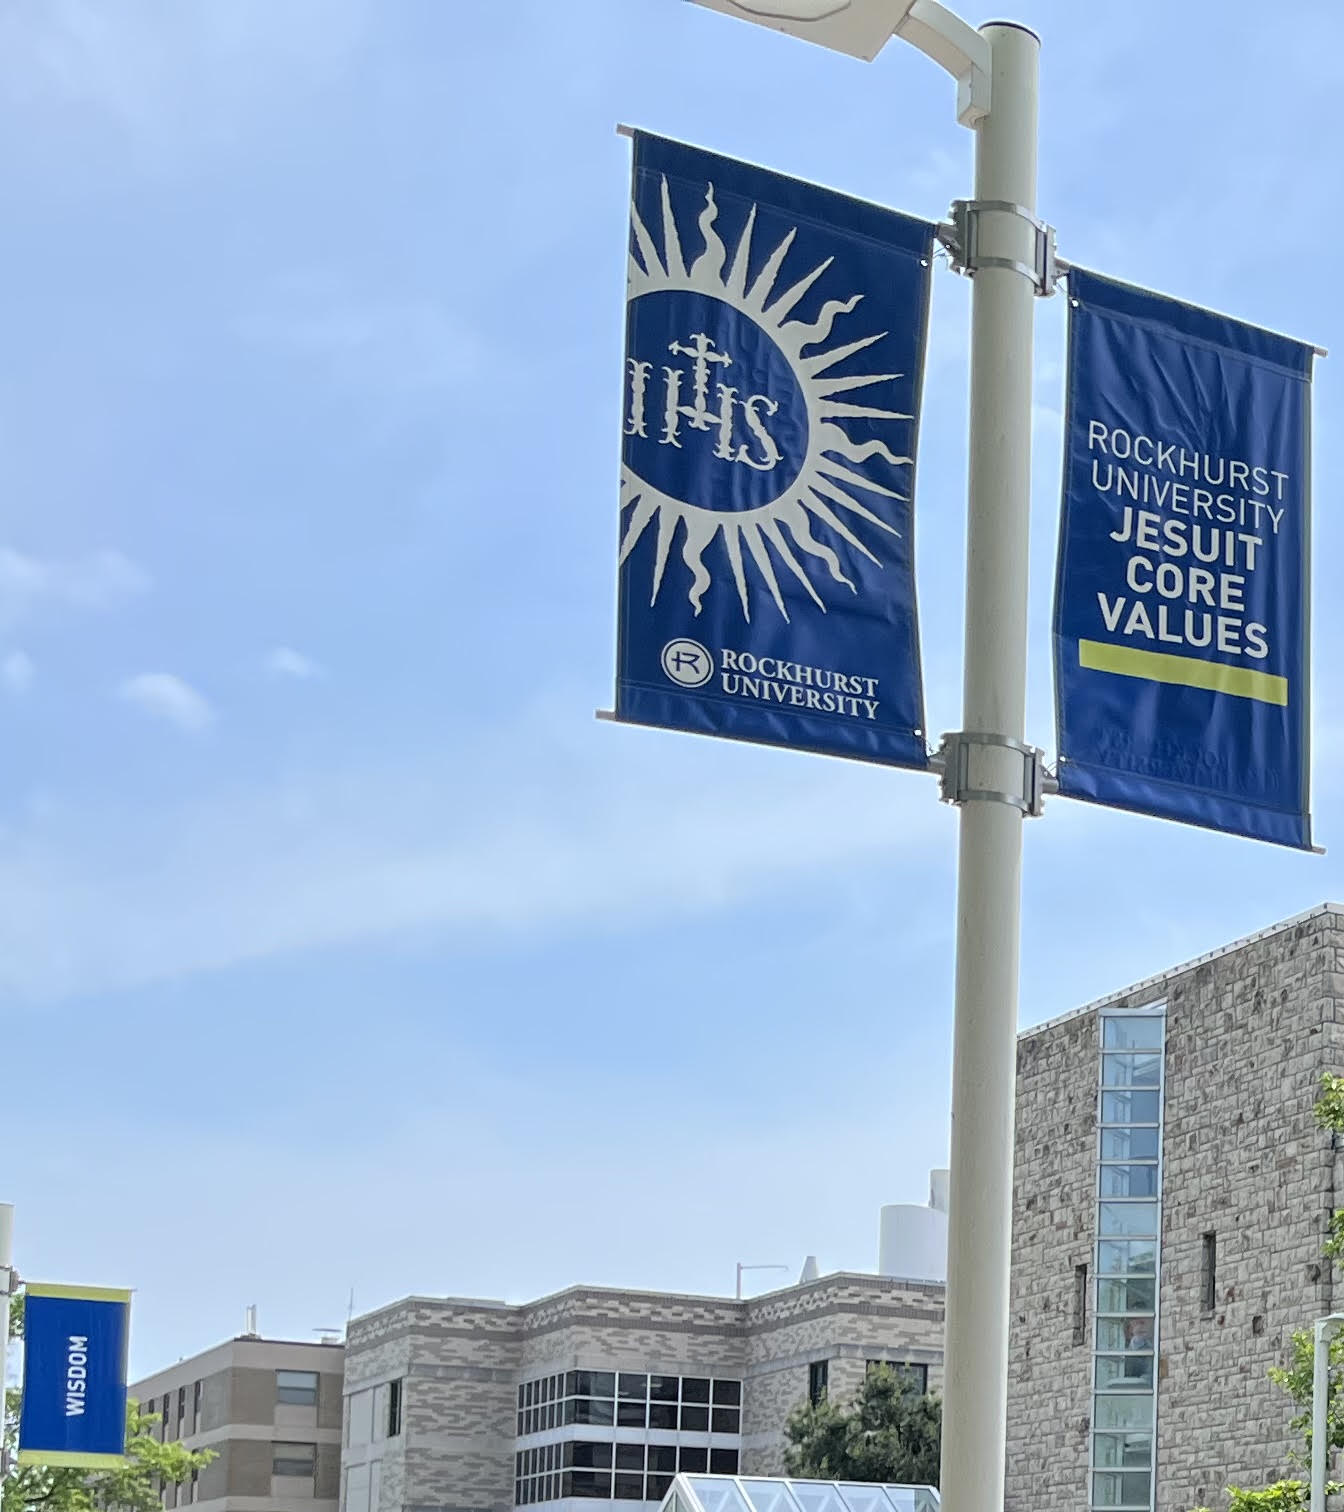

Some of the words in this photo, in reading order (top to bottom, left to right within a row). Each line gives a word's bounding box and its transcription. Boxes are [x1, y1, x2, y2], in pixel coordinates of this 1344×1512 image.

[624, 332, 784, 471] IHS
[1089, 420, 1290, 501] ROCKHURST
[1092, 459, 1286, 535] UNIVERSITY
[1110, 506, 1264, 571] JESUIT
[1126, 555, 1245, 612] CORE
[1097, 592, 1270, 660] VALUES
[720, 648, 879, 698] ROCKHURST
[721, 672, 880, 720] UNIVERSITY
[66, 1335, 88, 1417] WISDOM
